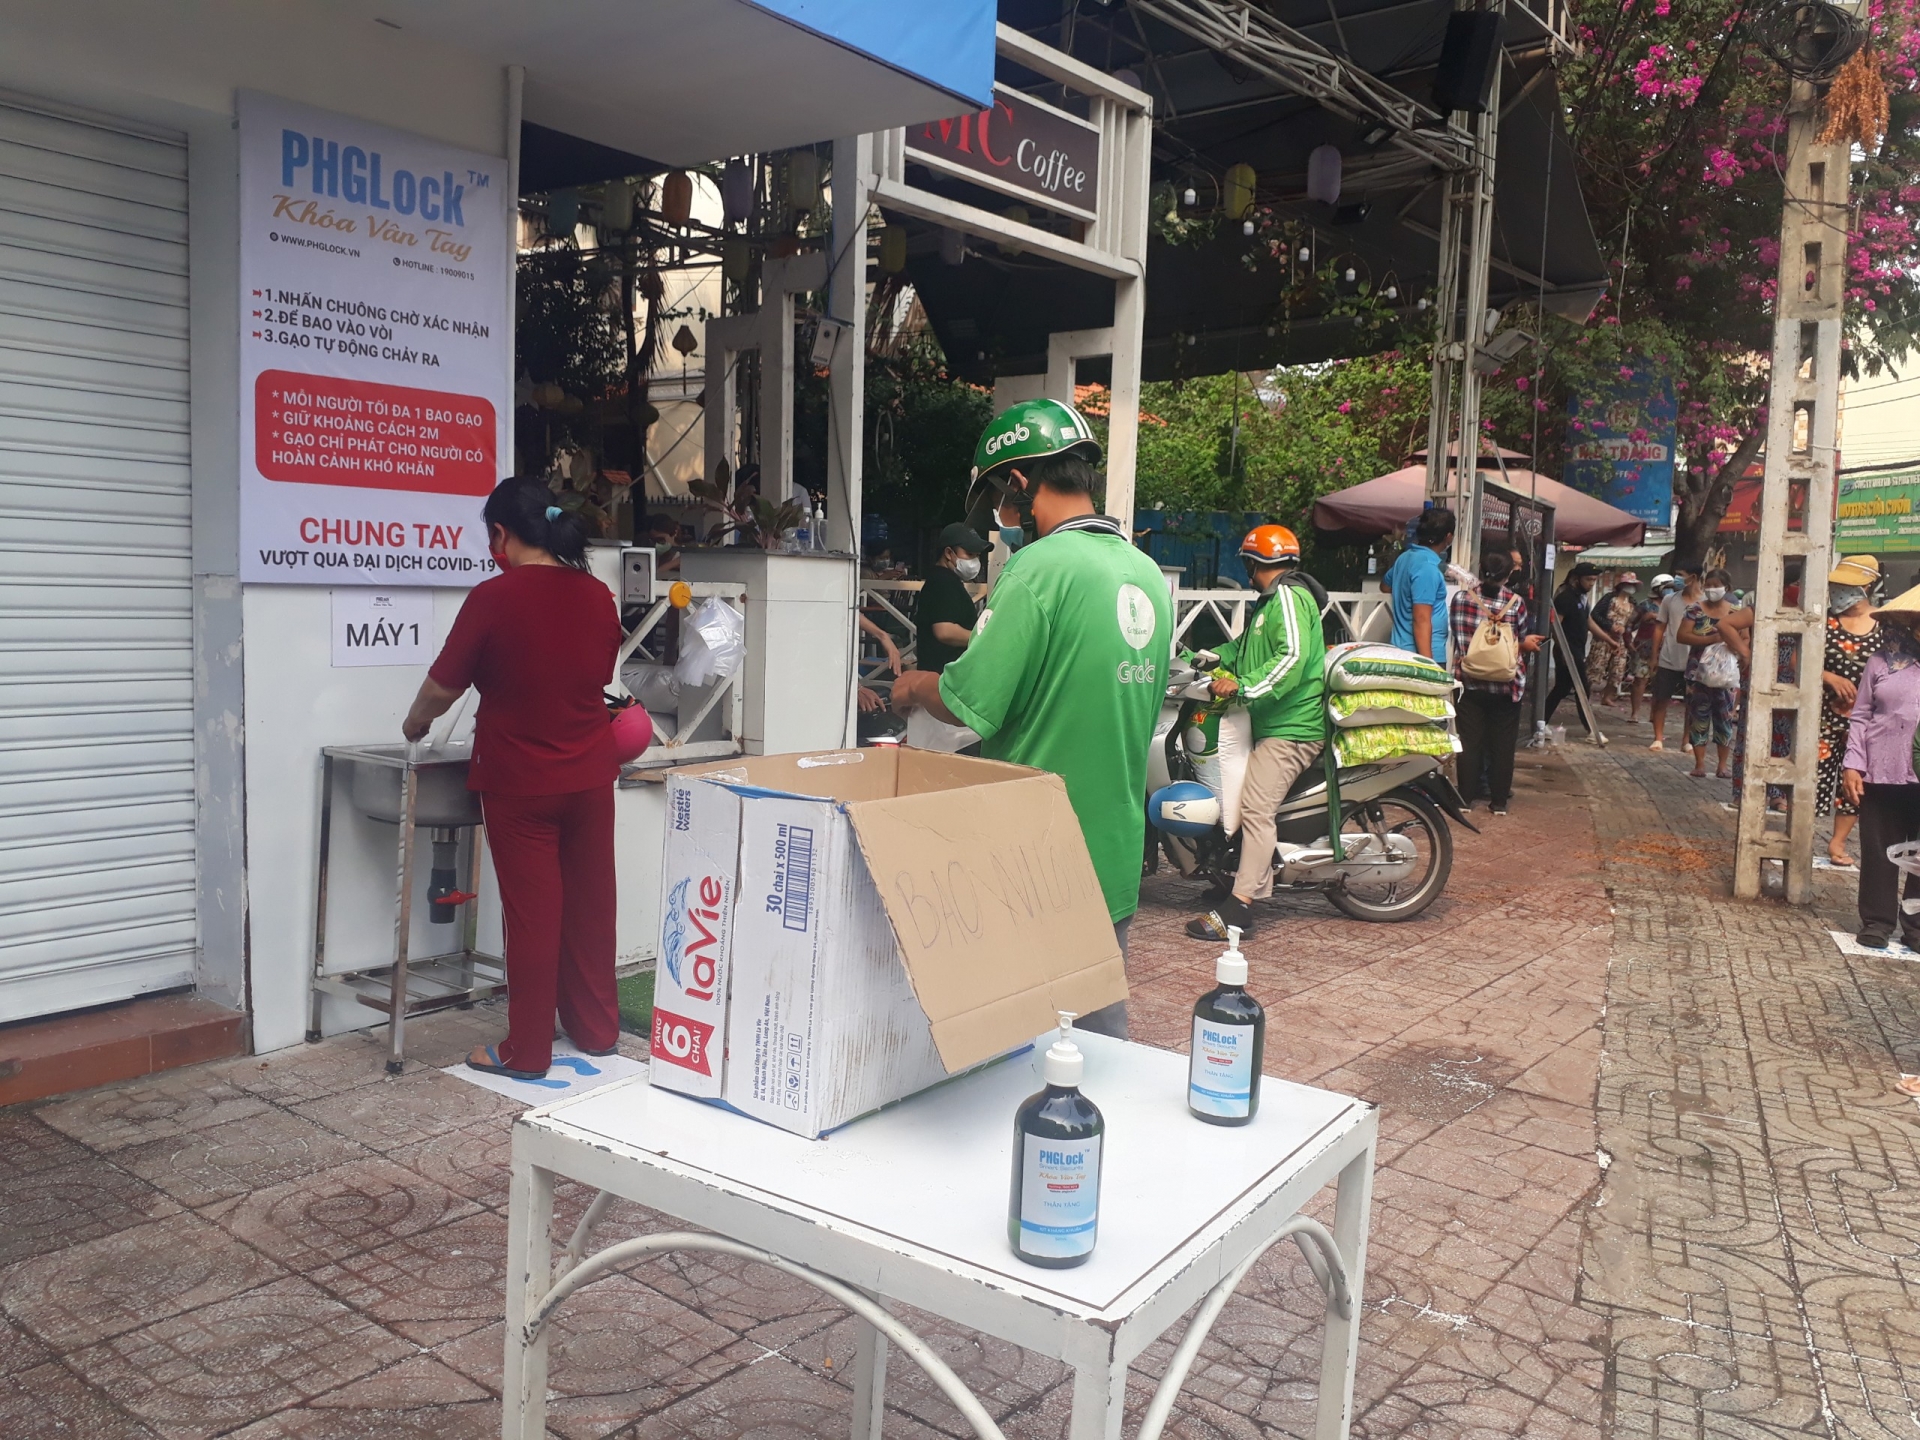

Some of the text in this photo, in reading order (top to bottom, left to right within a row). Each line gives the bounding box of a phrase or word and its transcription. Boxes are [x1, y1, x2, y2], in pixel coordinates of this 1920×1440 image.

[282, 128, 464, 228] PHGLock
[1017, 138, 1086, 192] Coffee
[272, 194, 472, 262] Khóa Vân Tay
[281, 234, 360, 258] WWW.PHGLOCK.VN
[402, 258, 475, 281] HOTLINE 19009015
[264, 308, 392, 341] 2.ĐỂ BAO VÀO VÒI
[265, 288, 489, 339] 1.NHẤN CHUÔNG CHỜ XÁC NHẬN
[264, 329, 440, 367] 3.GẠO TỰ ĐỘNG CHẢY RA
[283, 388, 482, 428] MỖI NGƯỜI TỐI ĐA 1 BAO GẠO
[283, 410, 439, 440] GIỮ KHOẢNG CÁCH 2M
[986, 423, 1030, 455] Grab
[283, 431, 483, 462] GẠO CHỈ PHÁT CHO NGƯỜI CÓ
[272, 449, 434, 476] HOÀN CẢNH KHÓ KHĂN
[300, 516, 464, 550] CHUNG TAY
[259, 550, 496, 572] VƯỢT QUA ĐẠI DỊCH COVID-19
[346, 616, 418, 646] MÁY 1
[1117, 658, 1156, 684] Grab
[675, 788, 684, 830] Nestlé
[682, 790, 691, 831] Waters
[777, 823, 787, 837] ml
[775, 840, 786, 860] 500
[773, 871, 784, 892] chai
[766, 894, 782, 915] 30
[896, 860, 984, 950] BAO
[662, 1022, 692, 1058] 6
[1202, 1029, 1237, 1045] PHGLock
[1040, 1149, 1084, 1165] PHGLock
